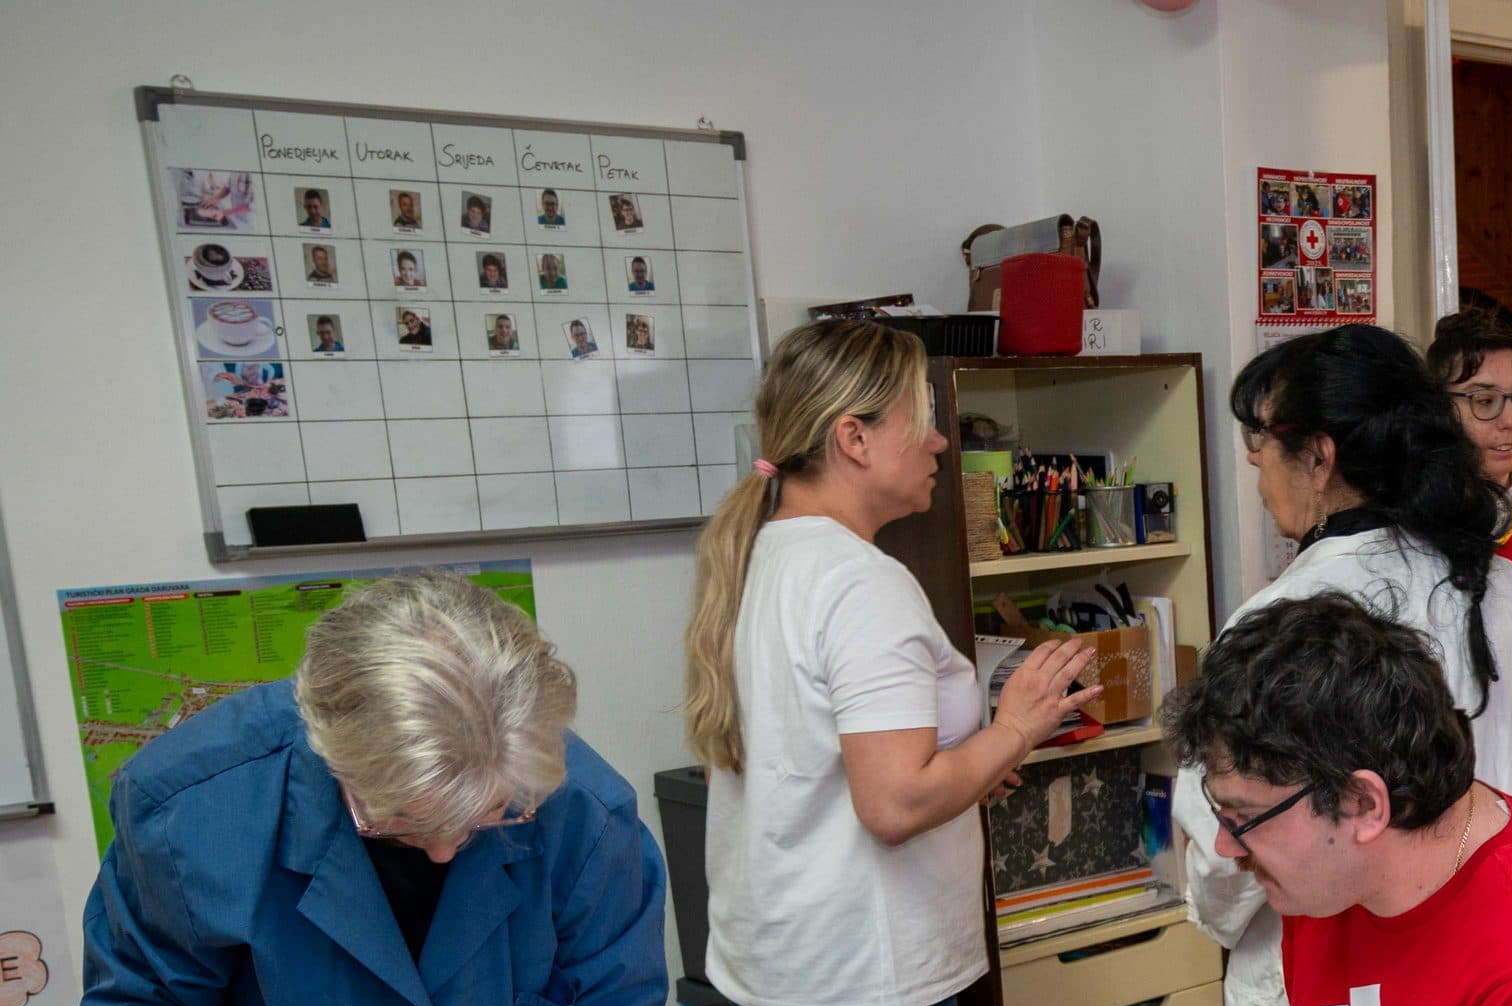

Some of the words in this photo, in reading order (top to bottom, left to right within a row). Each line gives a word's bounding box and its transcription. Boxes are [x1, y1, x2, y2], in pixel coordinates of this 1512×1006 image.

[261, 134, 339, 162] PONEDJELJAK
[356, 142, 415, 163] UTORAK
[438, 144, 495, 169] SRIJEDA
[521, 144, 583, 173] ČETVRTAK
[597, 154, 640, 181] PETAK
